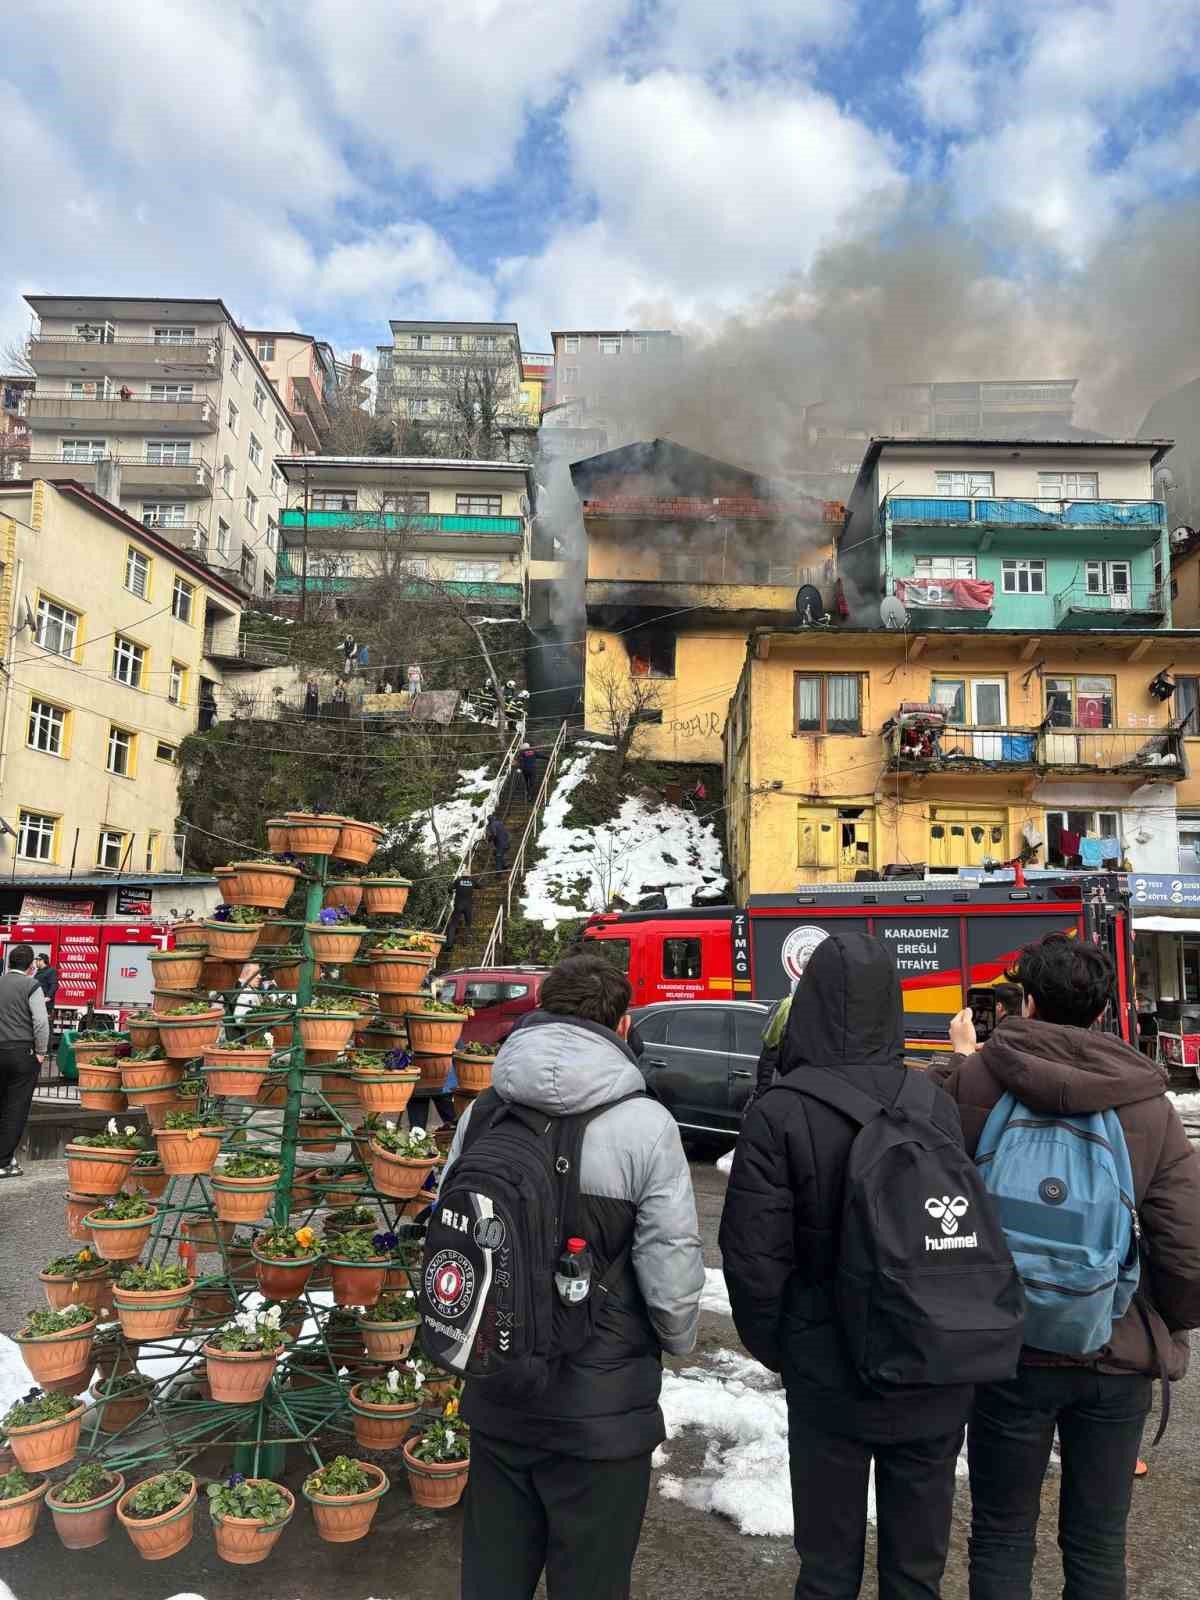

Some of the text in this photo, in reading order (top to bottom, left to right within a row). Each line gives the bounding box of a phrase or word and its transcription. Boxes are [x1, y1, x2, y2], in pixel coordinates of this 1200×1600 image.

[884, 926, 949, 939] KARADENİZ
[896, 942, 937, 954] EREĞLİ
[896, 957, 940, 970] İTFAİYE
[120, 967, 139, 979] 112
[924, 1231, 978, 1252] hummel
